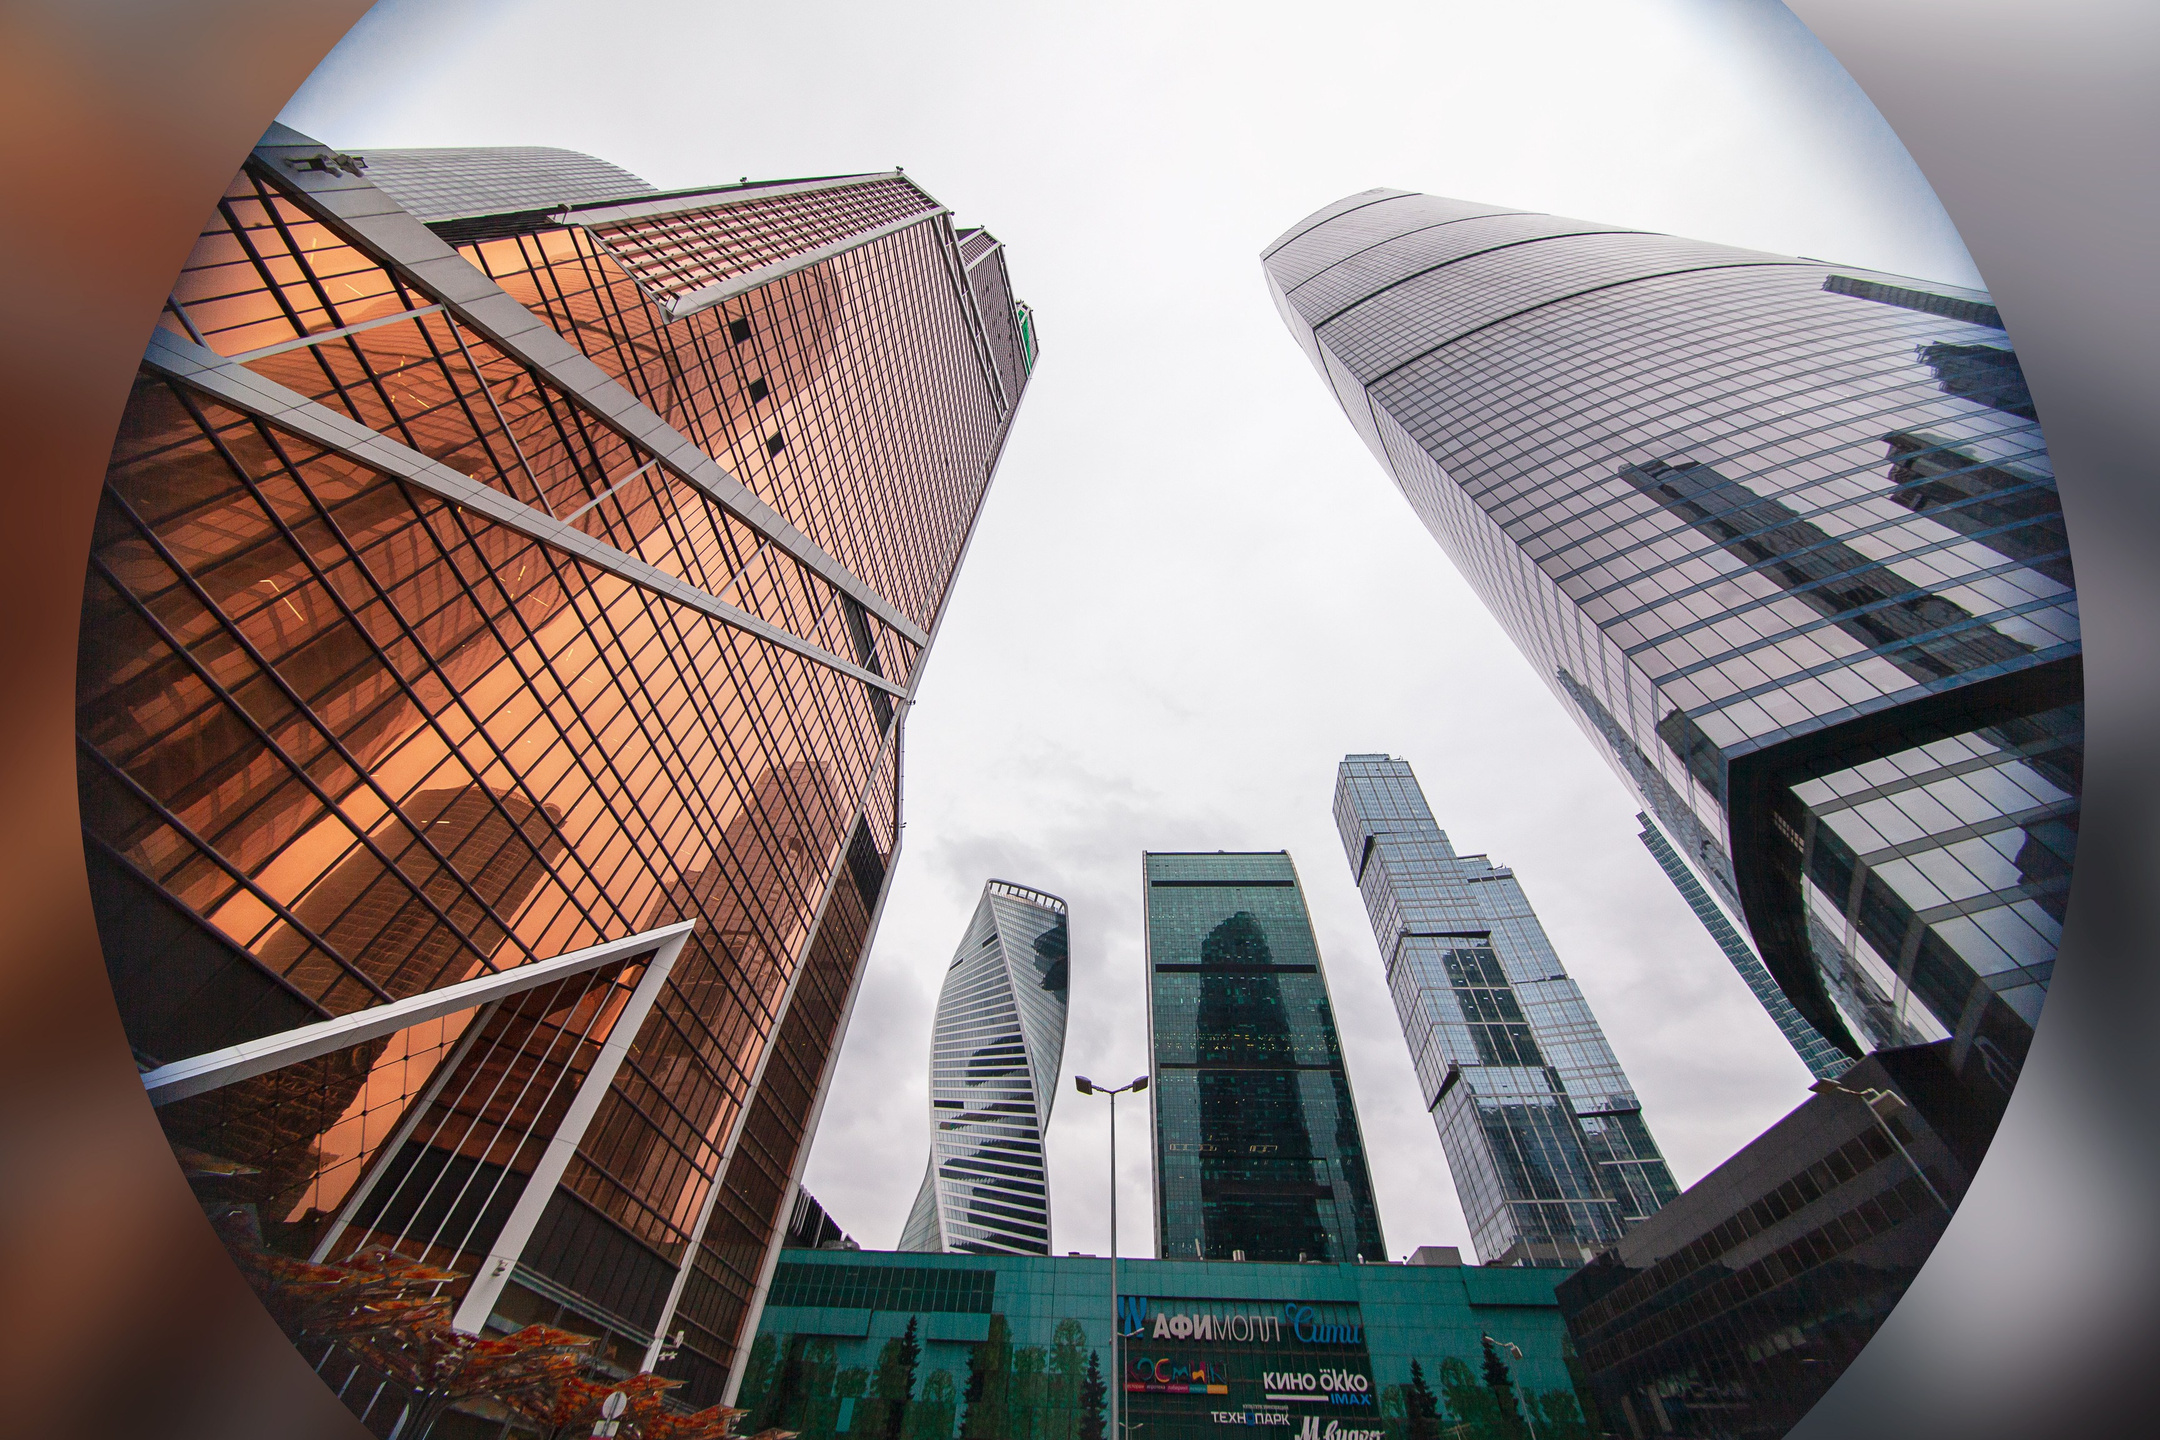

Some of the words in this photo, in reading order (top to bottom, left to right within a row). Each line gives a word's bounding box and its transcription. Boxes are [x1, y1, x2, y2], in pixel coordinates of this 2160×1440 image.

[1152, 1312, 1280, 1342] АФИМОЛЛ
[1263, 1371, 1317, 1391] КИНО
[1331, 1393, 1371, 1405] IMAX
[1211, 1411, 1290, 1426] ТЕХНОПАРК
